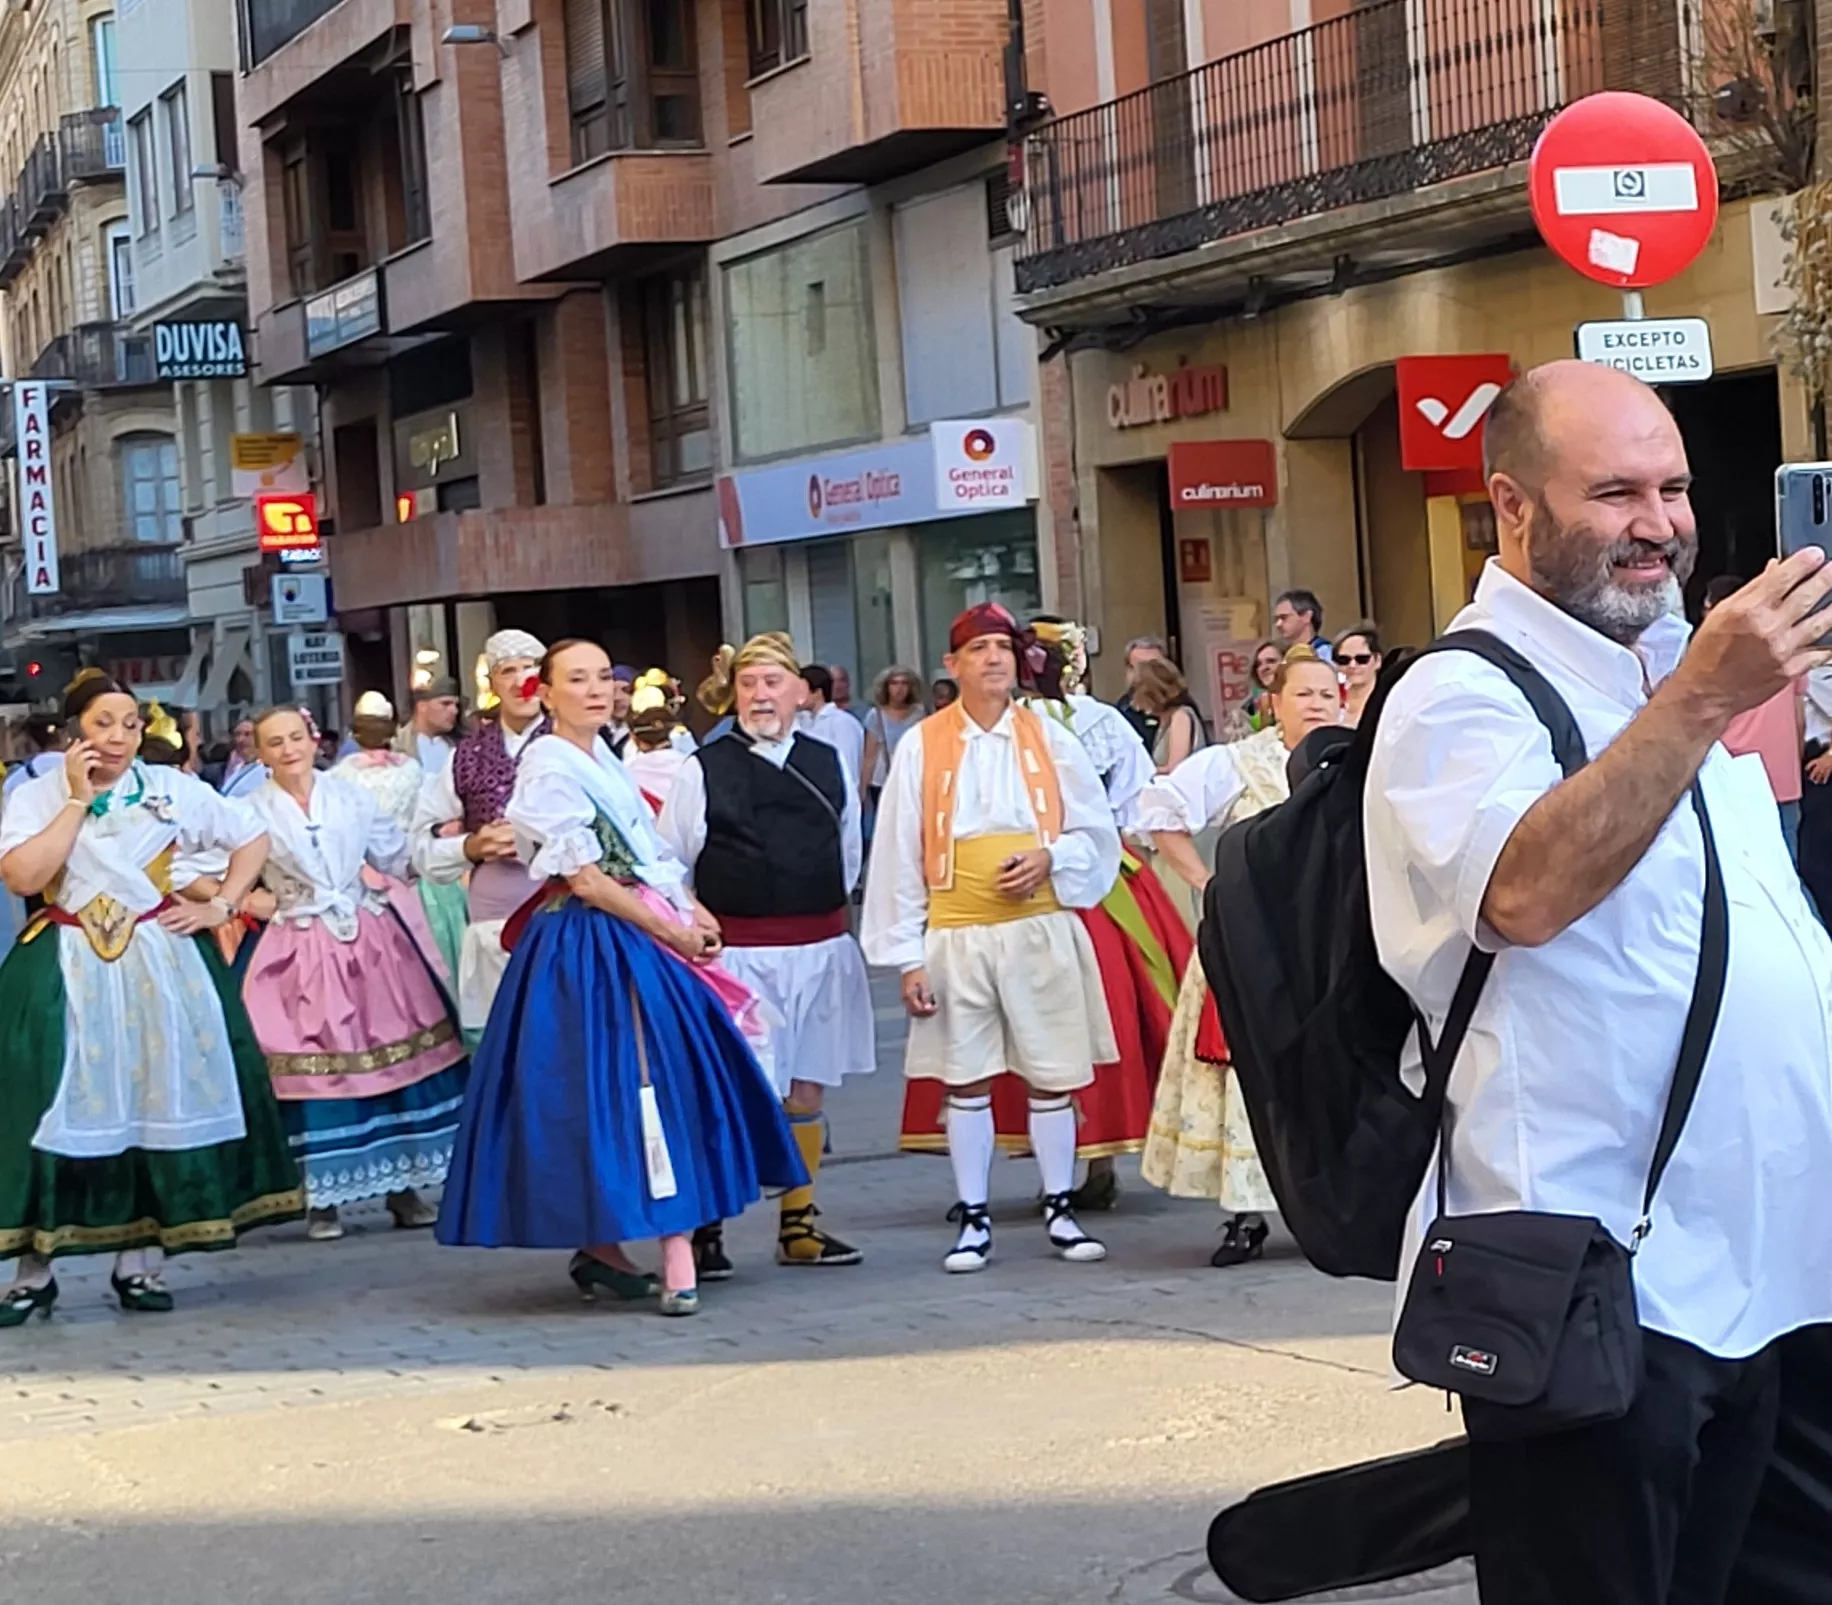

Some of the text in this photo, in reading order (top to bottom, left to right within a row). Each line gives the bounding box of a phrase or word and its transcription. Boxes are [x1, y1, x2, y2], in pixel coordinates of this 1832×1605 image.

[156, 322, 244, 362] DUVISA
[1603, 331, 1685, 348] EXCEPTO
[160, 363, 245, 377] ASESORES
[1108, 355, 1228, 427] culinarium
[949, 465, 1013, 481] General
[22, 388, 50, 587] FARMACIA
[824, 470, 900, 508] General Optica
[956, 484, 1009, 500] Optica
[1181, 481, 1263, 500] culinarium
